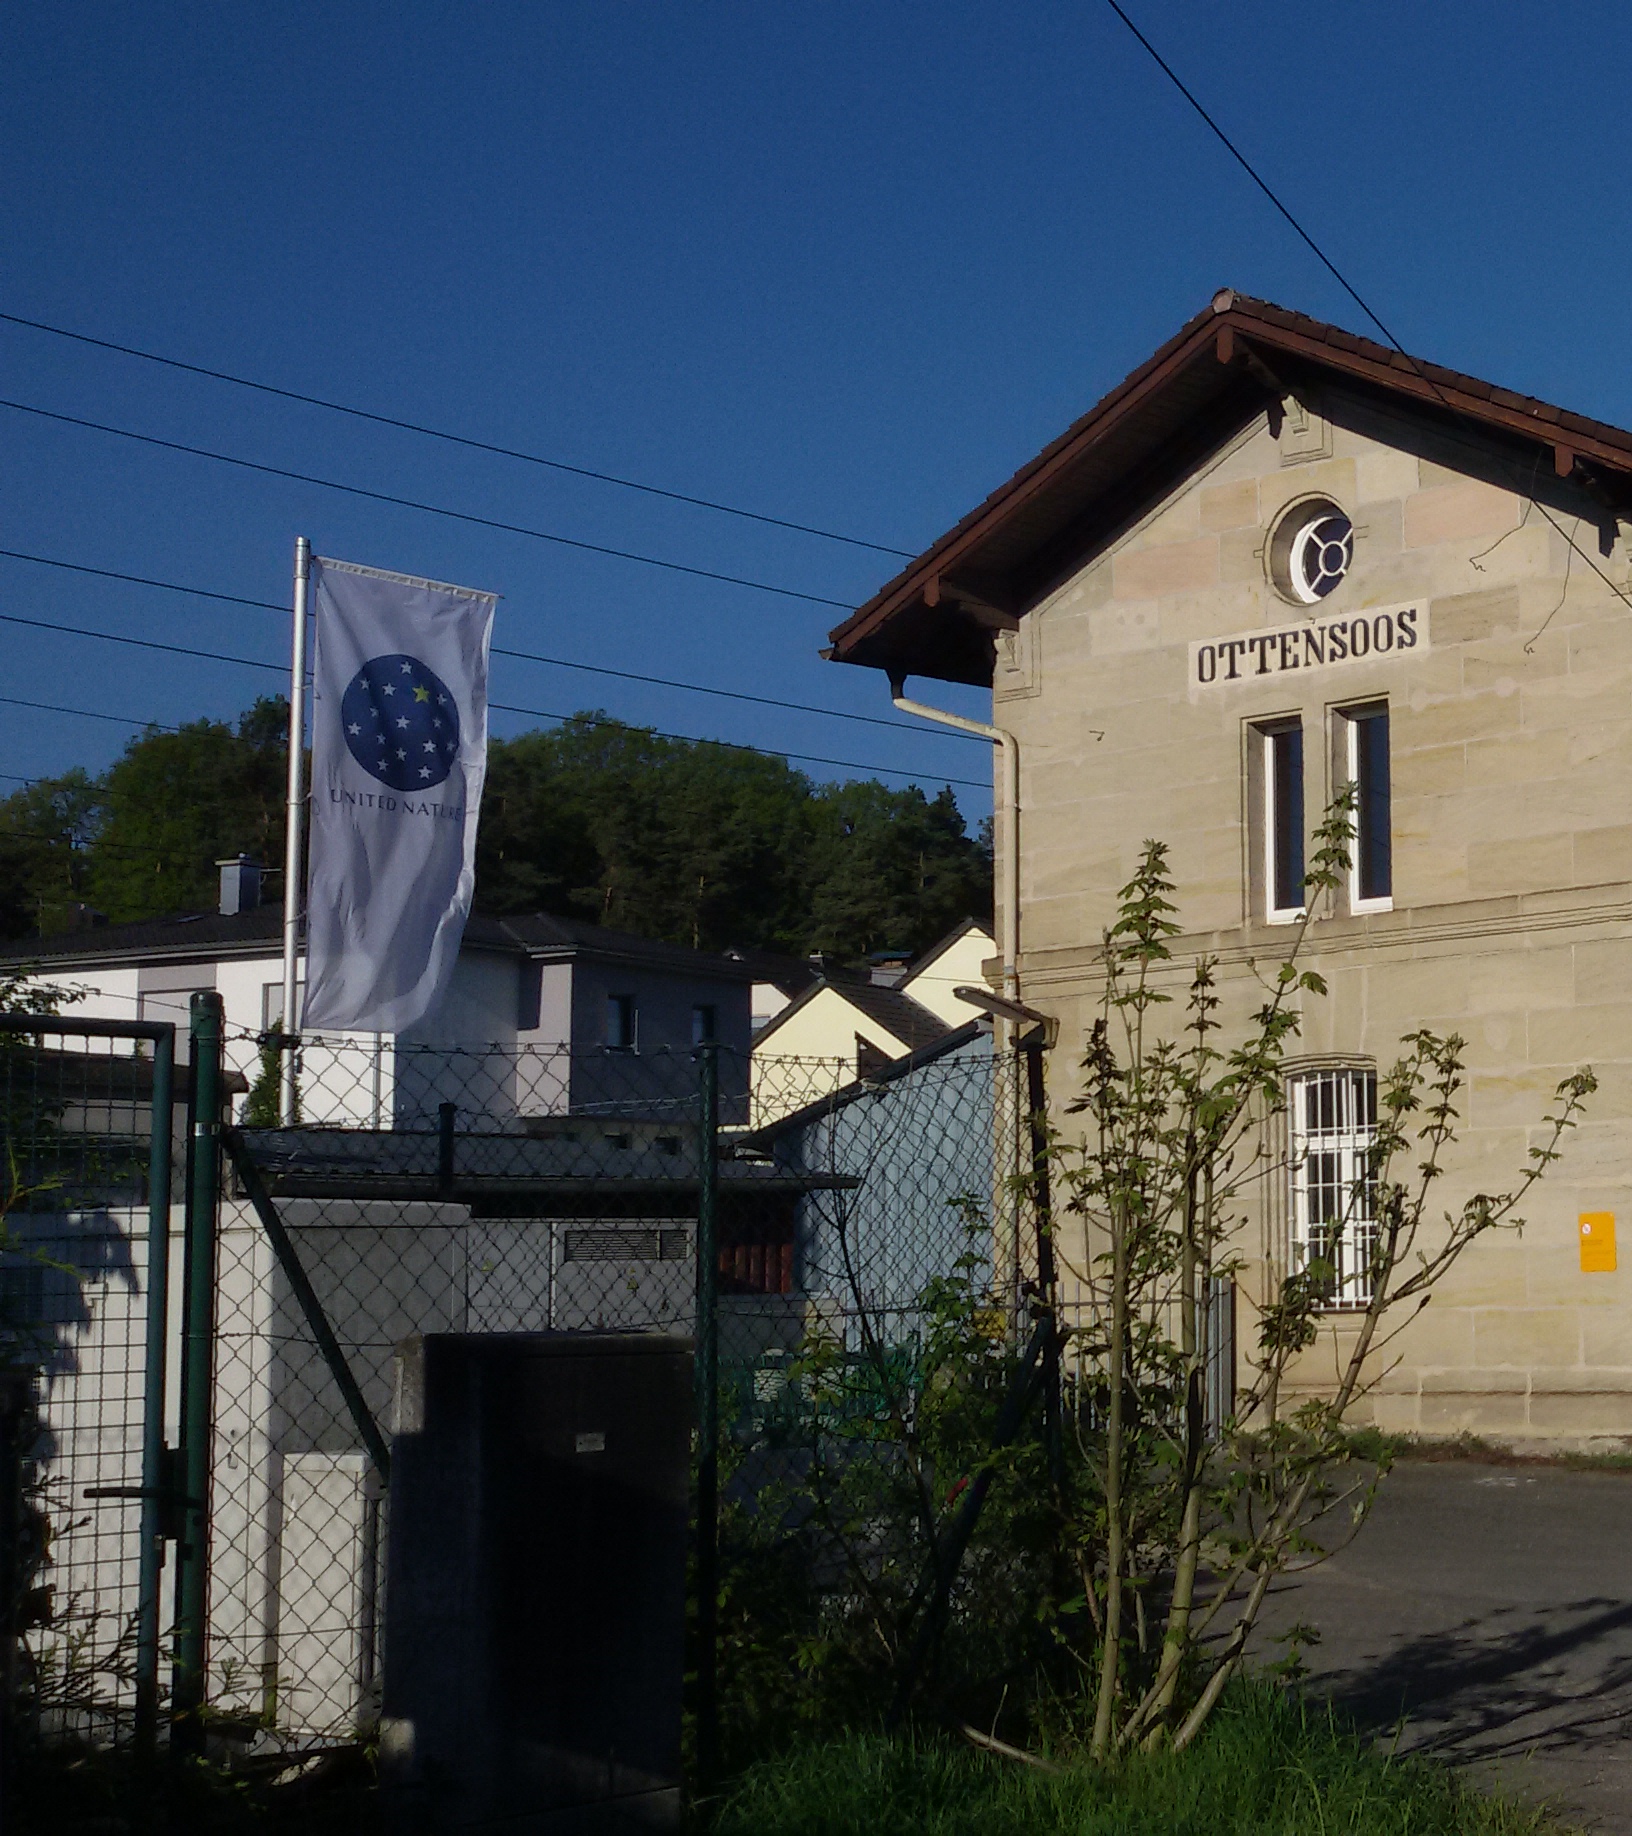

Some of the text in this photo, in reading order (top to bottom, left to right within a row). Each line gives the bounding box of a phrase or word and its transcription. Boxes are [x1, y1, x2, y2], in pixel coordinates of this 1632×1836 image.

[1197, 608, 1418, 683] OTTENSOOS
[330, 789, 462, 821] UNITED NATURE
